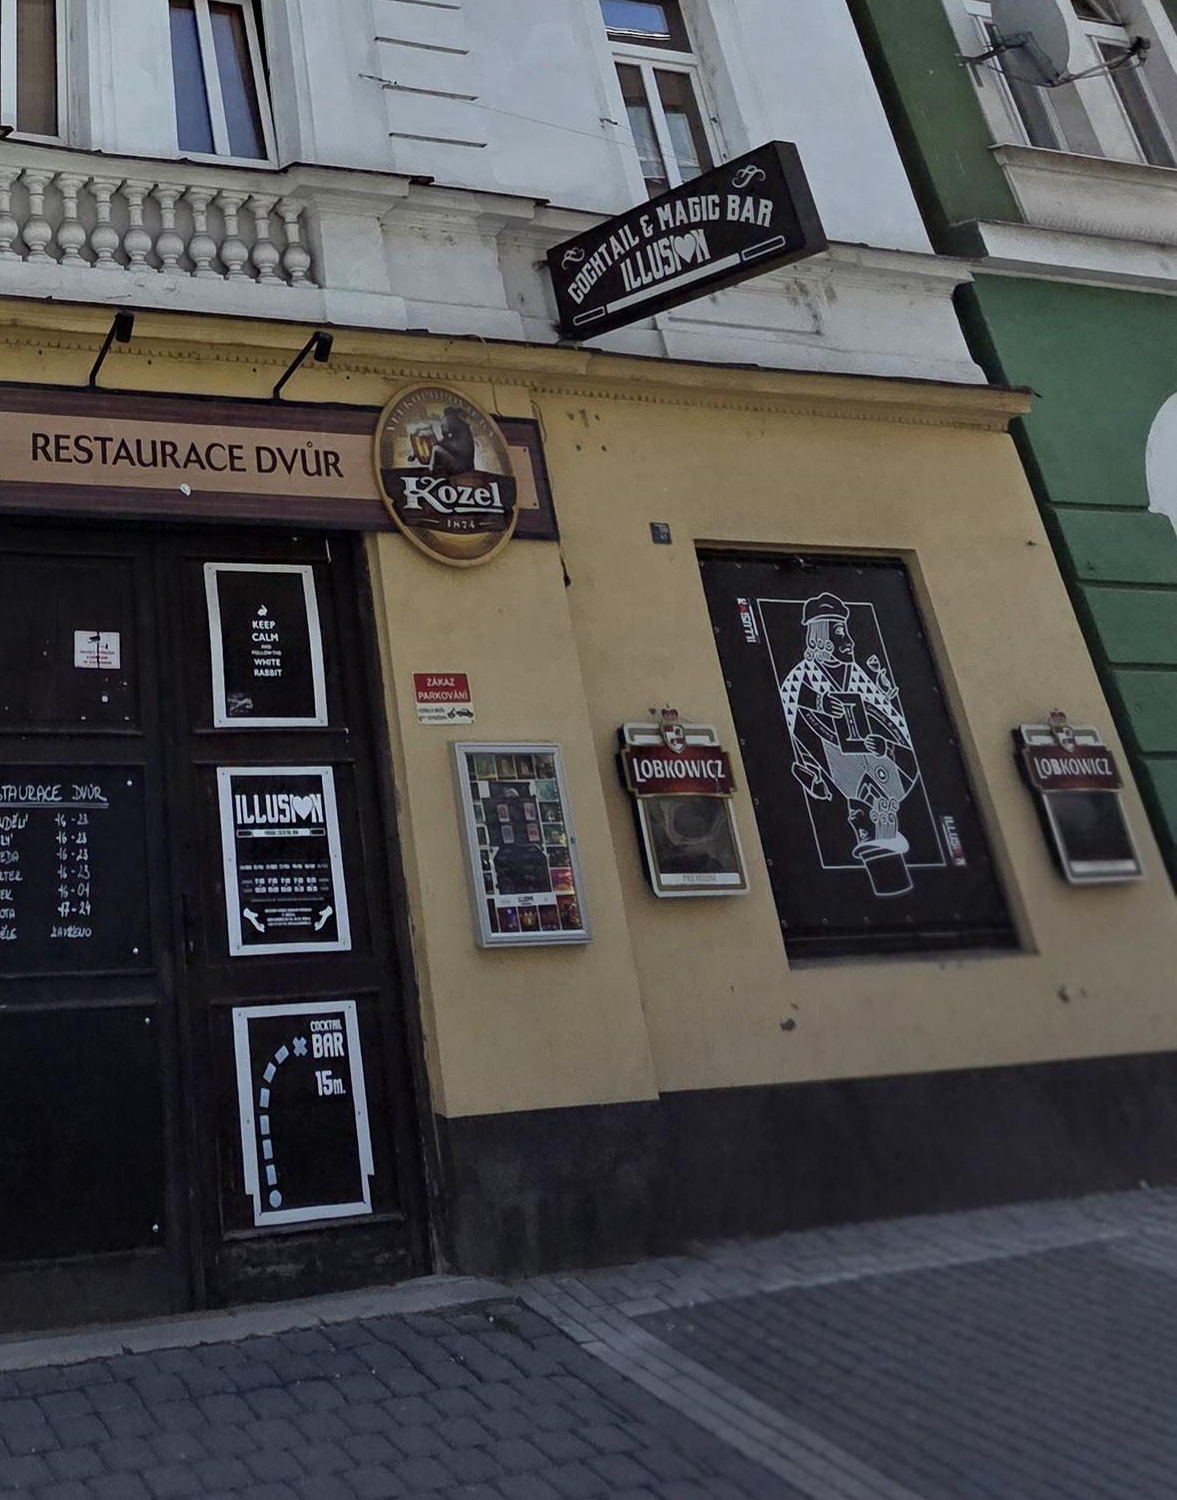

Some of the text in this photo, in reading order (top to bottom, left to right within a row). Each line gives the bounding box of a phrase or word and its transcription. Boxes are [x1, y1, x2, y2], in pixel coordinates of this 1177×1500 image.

[639, 215, 654, 238] &
[656, 194, 720, 231] MAGIC
[726, 195, 774, 228] BAR
[31, 432, 344, 479] RESTAURACE DVŮR
[400, 476, 505, 514] Kozel
[446, 519, 475, 528] 1874
[252, 620, 276, 629] KEEP
[251, 632, 279, 642] CALM
[253, 658, 281, 667] WHITE
[253, 668, 282, 677] RABBIT
[426, 677, 456, 687] ZÁKAZ
[417, 689, 468, 700] PARKOVÁNÍ
[633, 757, 726, 783] LOBKOWICZ
[1033, 756, 1113, 780] LOBKOWICZ
[310, 1019, 342, 1032] COCKTAIL
[312, 1032, 344, 1058] BAR
